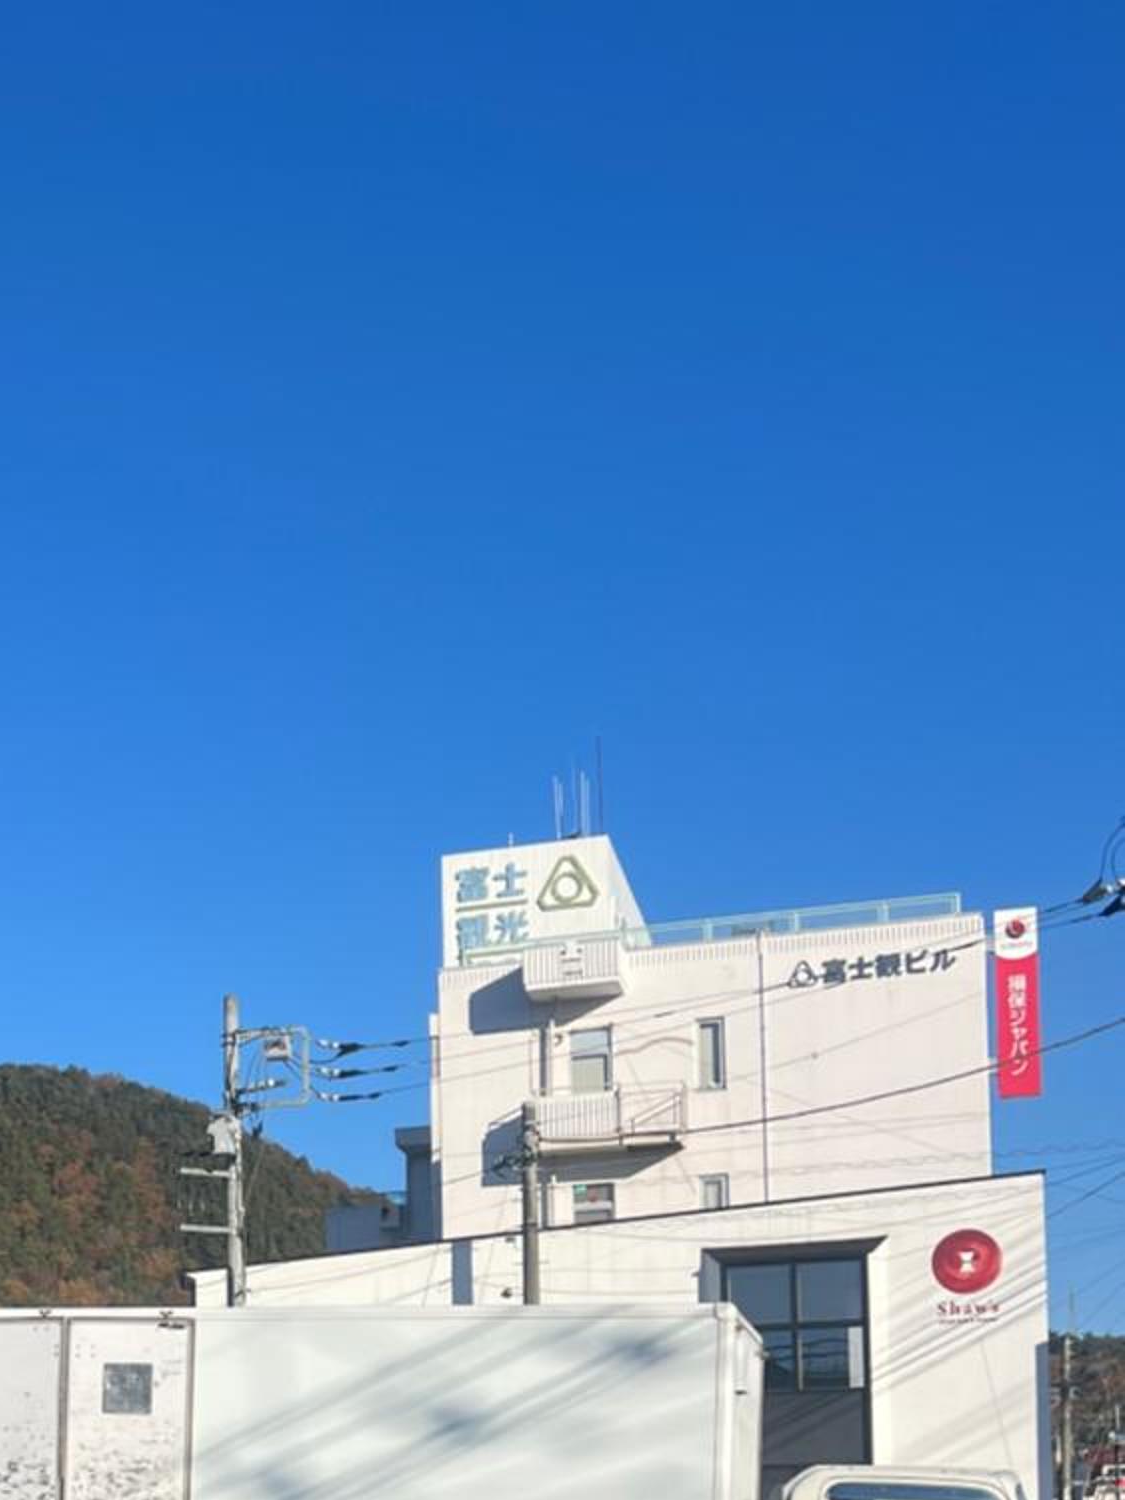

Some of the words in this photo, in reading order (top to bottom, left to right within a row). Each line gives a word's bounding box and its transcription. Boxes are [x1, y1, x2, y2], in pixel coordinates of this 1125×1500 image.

[822, 949, 956, 984] 富士観ビル
